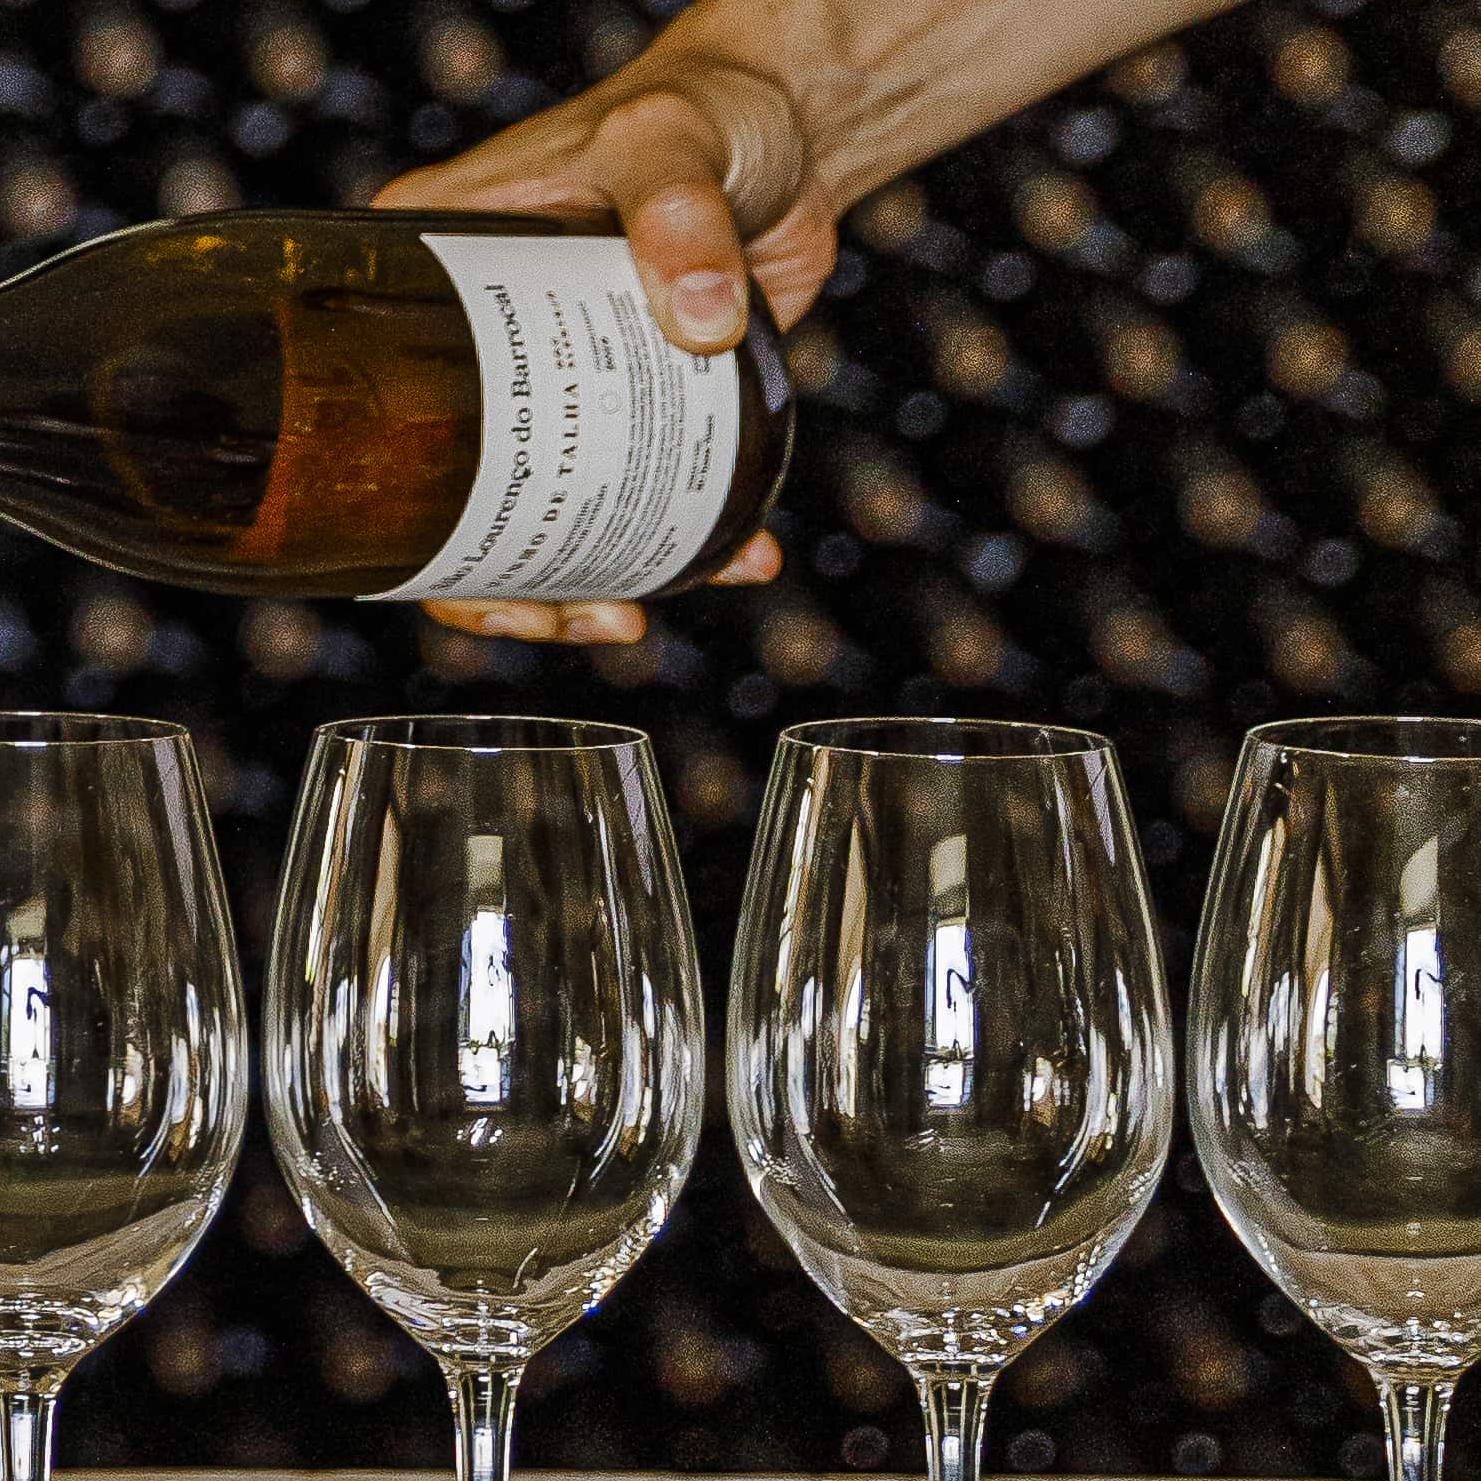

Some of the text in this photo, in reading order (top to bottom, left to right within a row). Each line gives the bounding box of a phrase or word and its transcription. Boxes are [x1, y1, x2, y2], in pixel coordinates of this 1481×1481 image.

[484, 285, 531, 397] Barrocal
[511, 407, 532, 442] do
[542, 490, 568, 522] DE
[558, 383, 579, 479] TALHA
[462, 450, 532, 562] Lourenço
